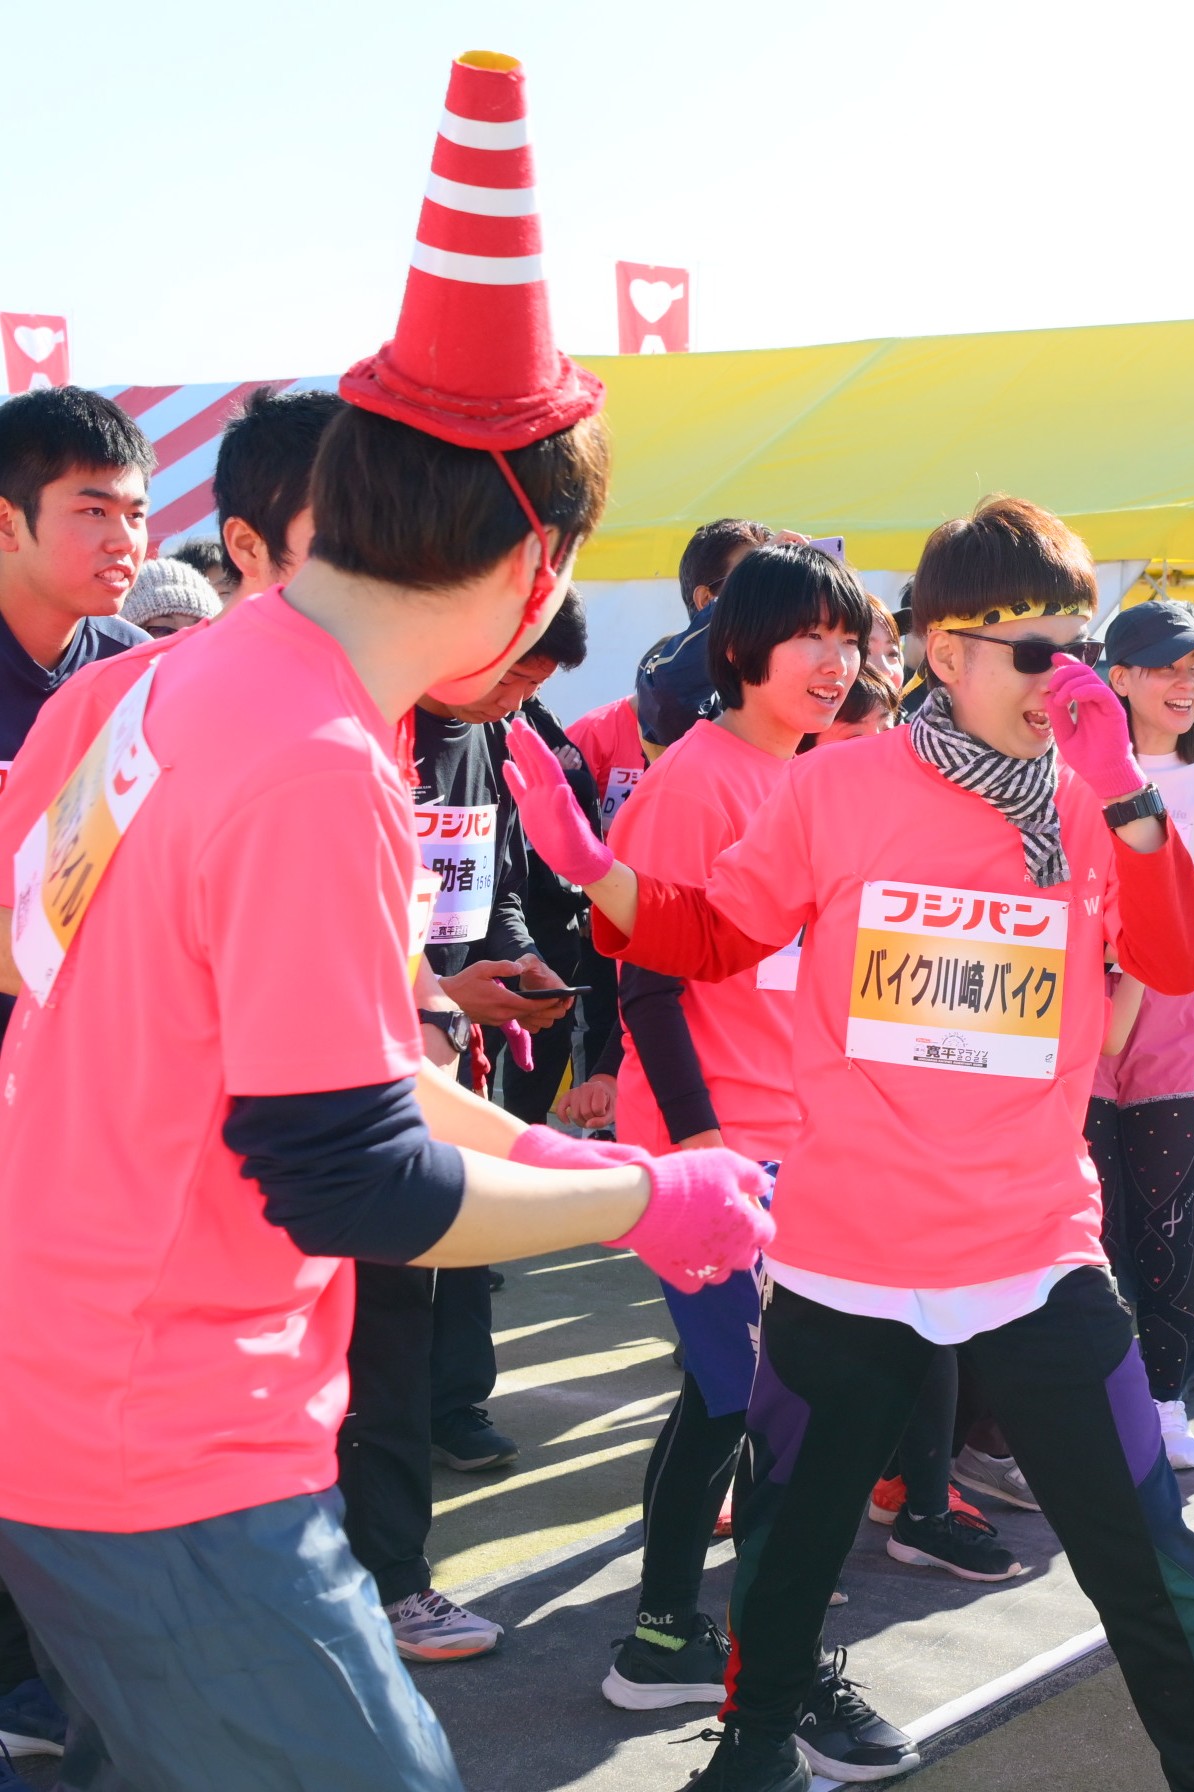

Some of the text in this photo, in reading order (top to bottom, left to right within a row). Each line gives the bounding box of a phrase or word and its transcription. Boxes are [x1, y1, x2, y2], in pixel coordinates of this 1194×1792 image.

[414, 812, 492, 838] フジパン
[881, 888, 1050, 938] フジパン
[860, 949, 1057, 1019] バイク川崎バイク
